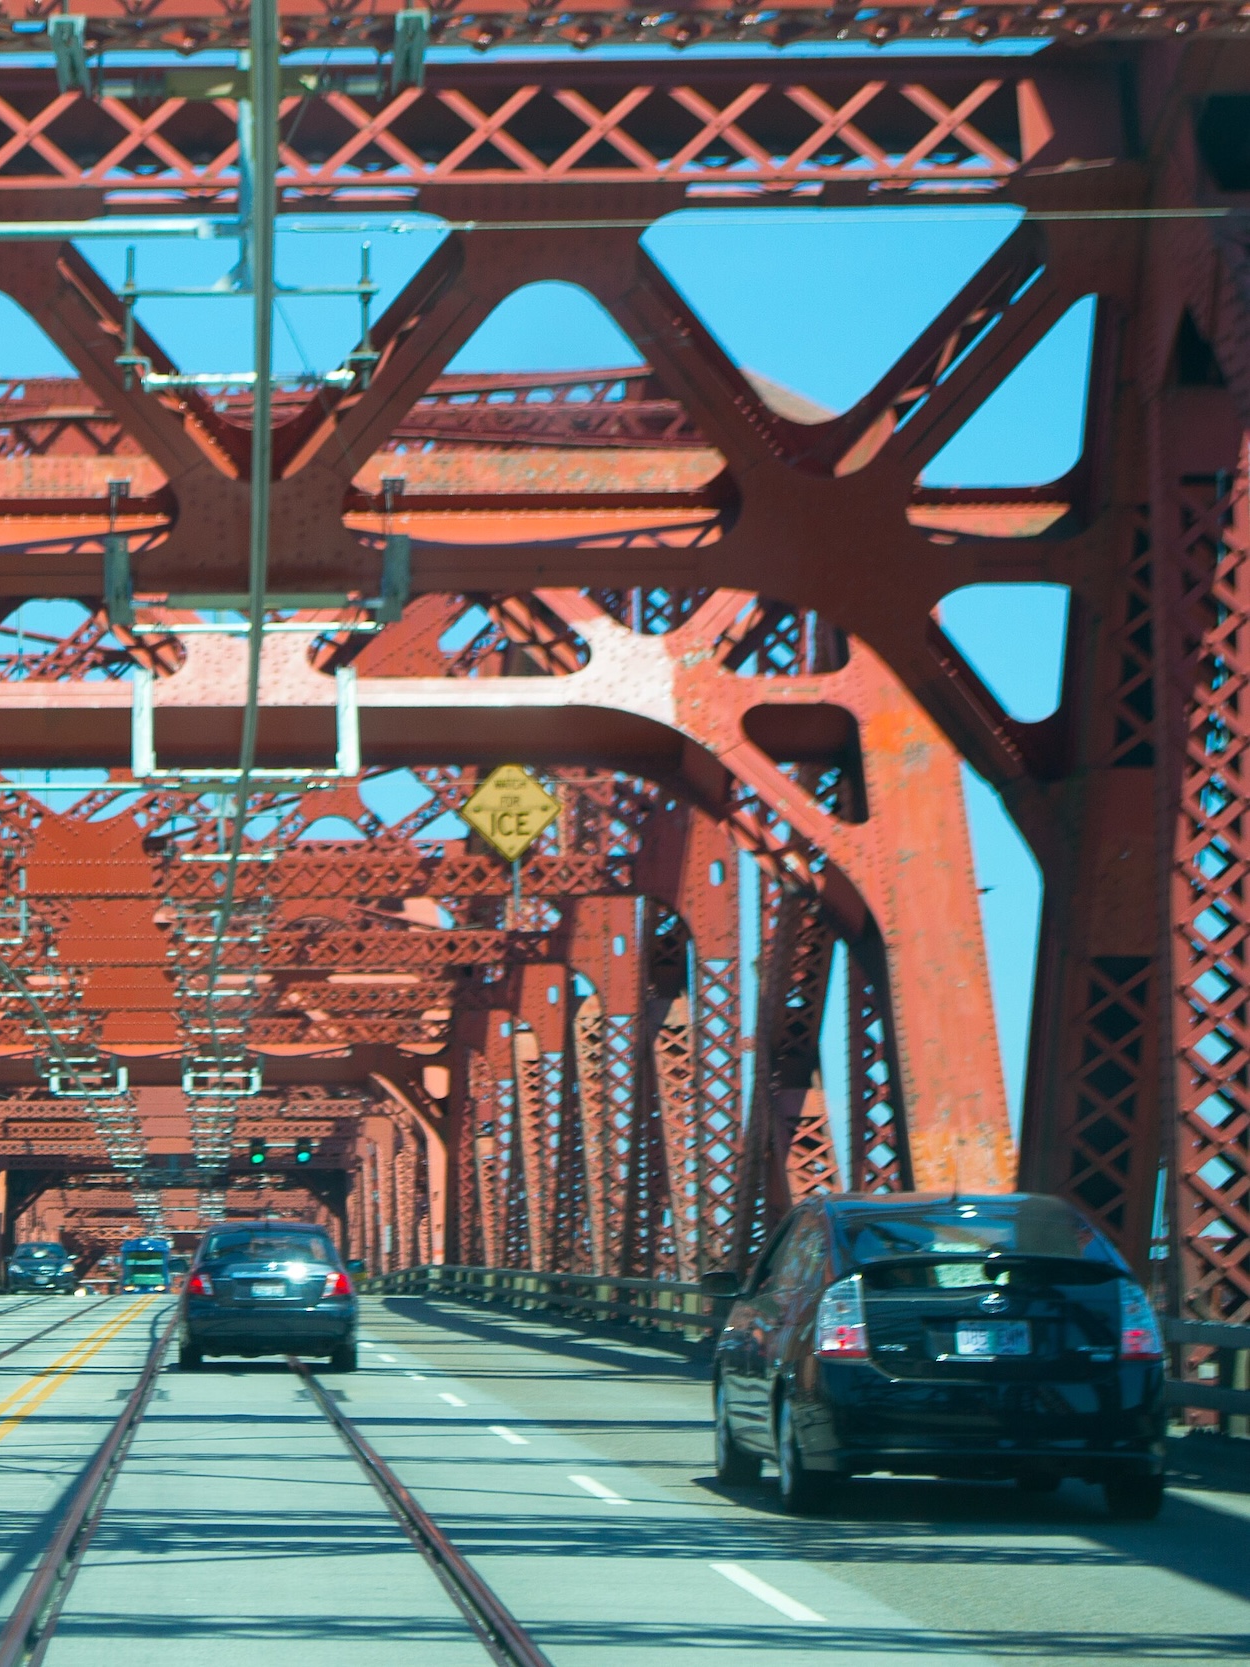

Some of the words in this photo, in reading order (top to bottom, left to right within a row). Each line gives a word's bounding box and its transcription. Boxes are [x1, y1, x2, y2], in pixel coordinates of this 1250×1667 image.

[494, 779, 527, 790] WATCH
[500, 796, 520, 807] FOR
[490, 811, 531, 837] ICE
